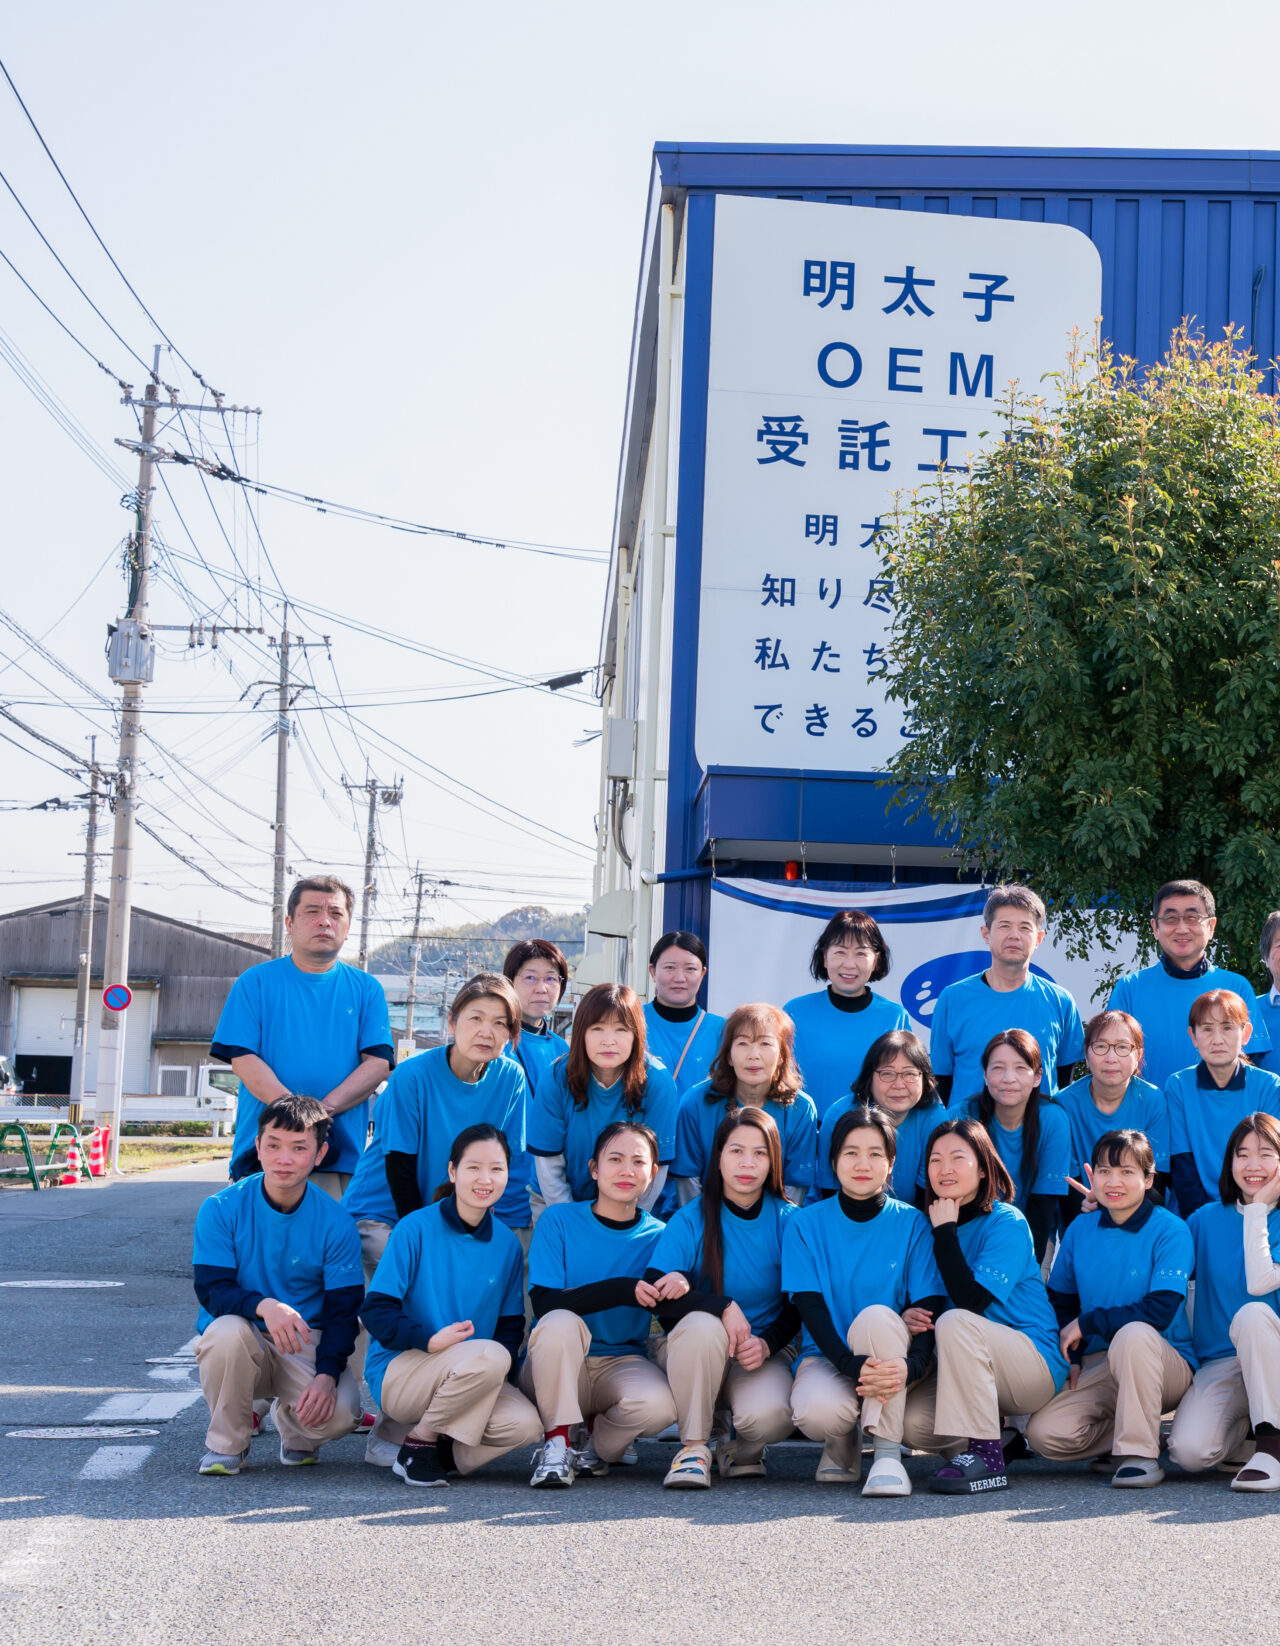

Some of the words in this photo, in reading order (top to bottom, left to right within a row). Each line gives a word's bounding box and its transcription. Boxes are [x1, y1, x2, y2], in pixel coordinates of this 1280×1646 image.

[803, 260, 1014, 322] 明太子
[818, 342, 993, 398] OEM
[757, 415, 1043, 478] 受託工
